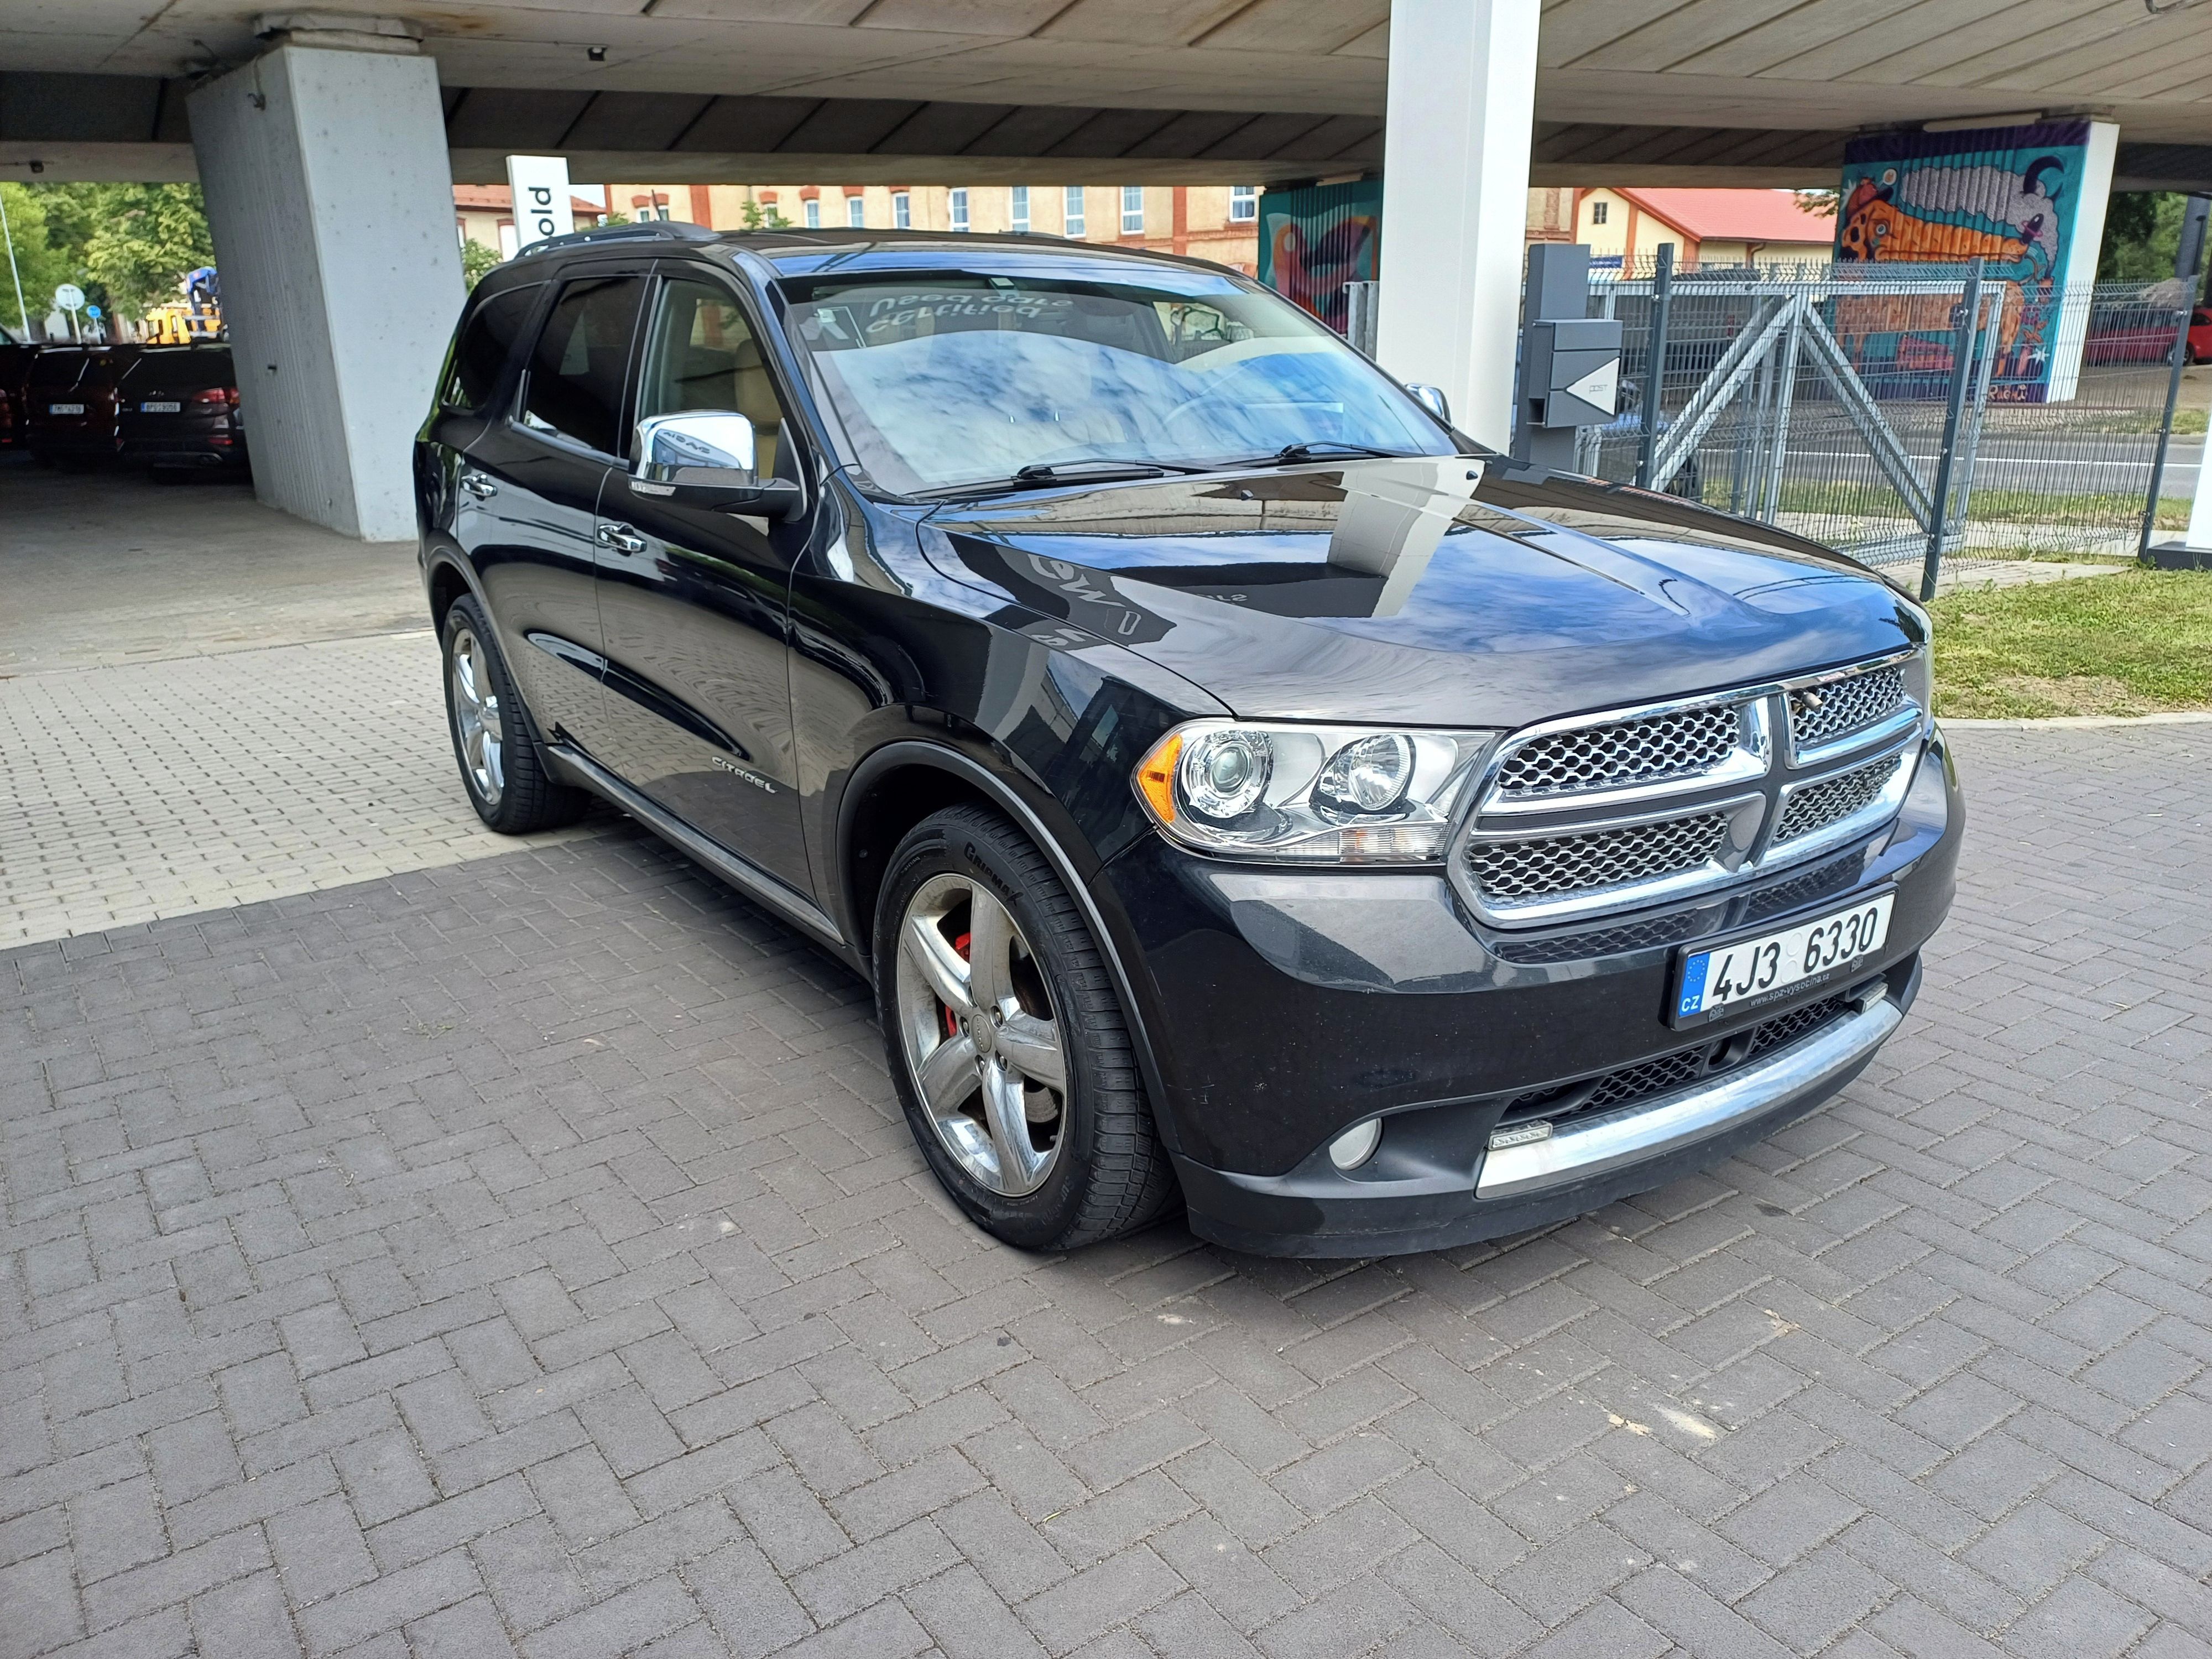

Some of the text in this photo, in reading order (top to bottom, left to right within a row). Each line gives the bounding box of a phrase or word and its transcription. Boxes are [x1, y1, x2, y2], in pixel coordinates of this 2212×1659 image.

[711, 755, 779, 794] CITADEL
[1712, 907, 1878, 1001] 4J3 6330
[1681, 994, 1700, 1013] CZ
